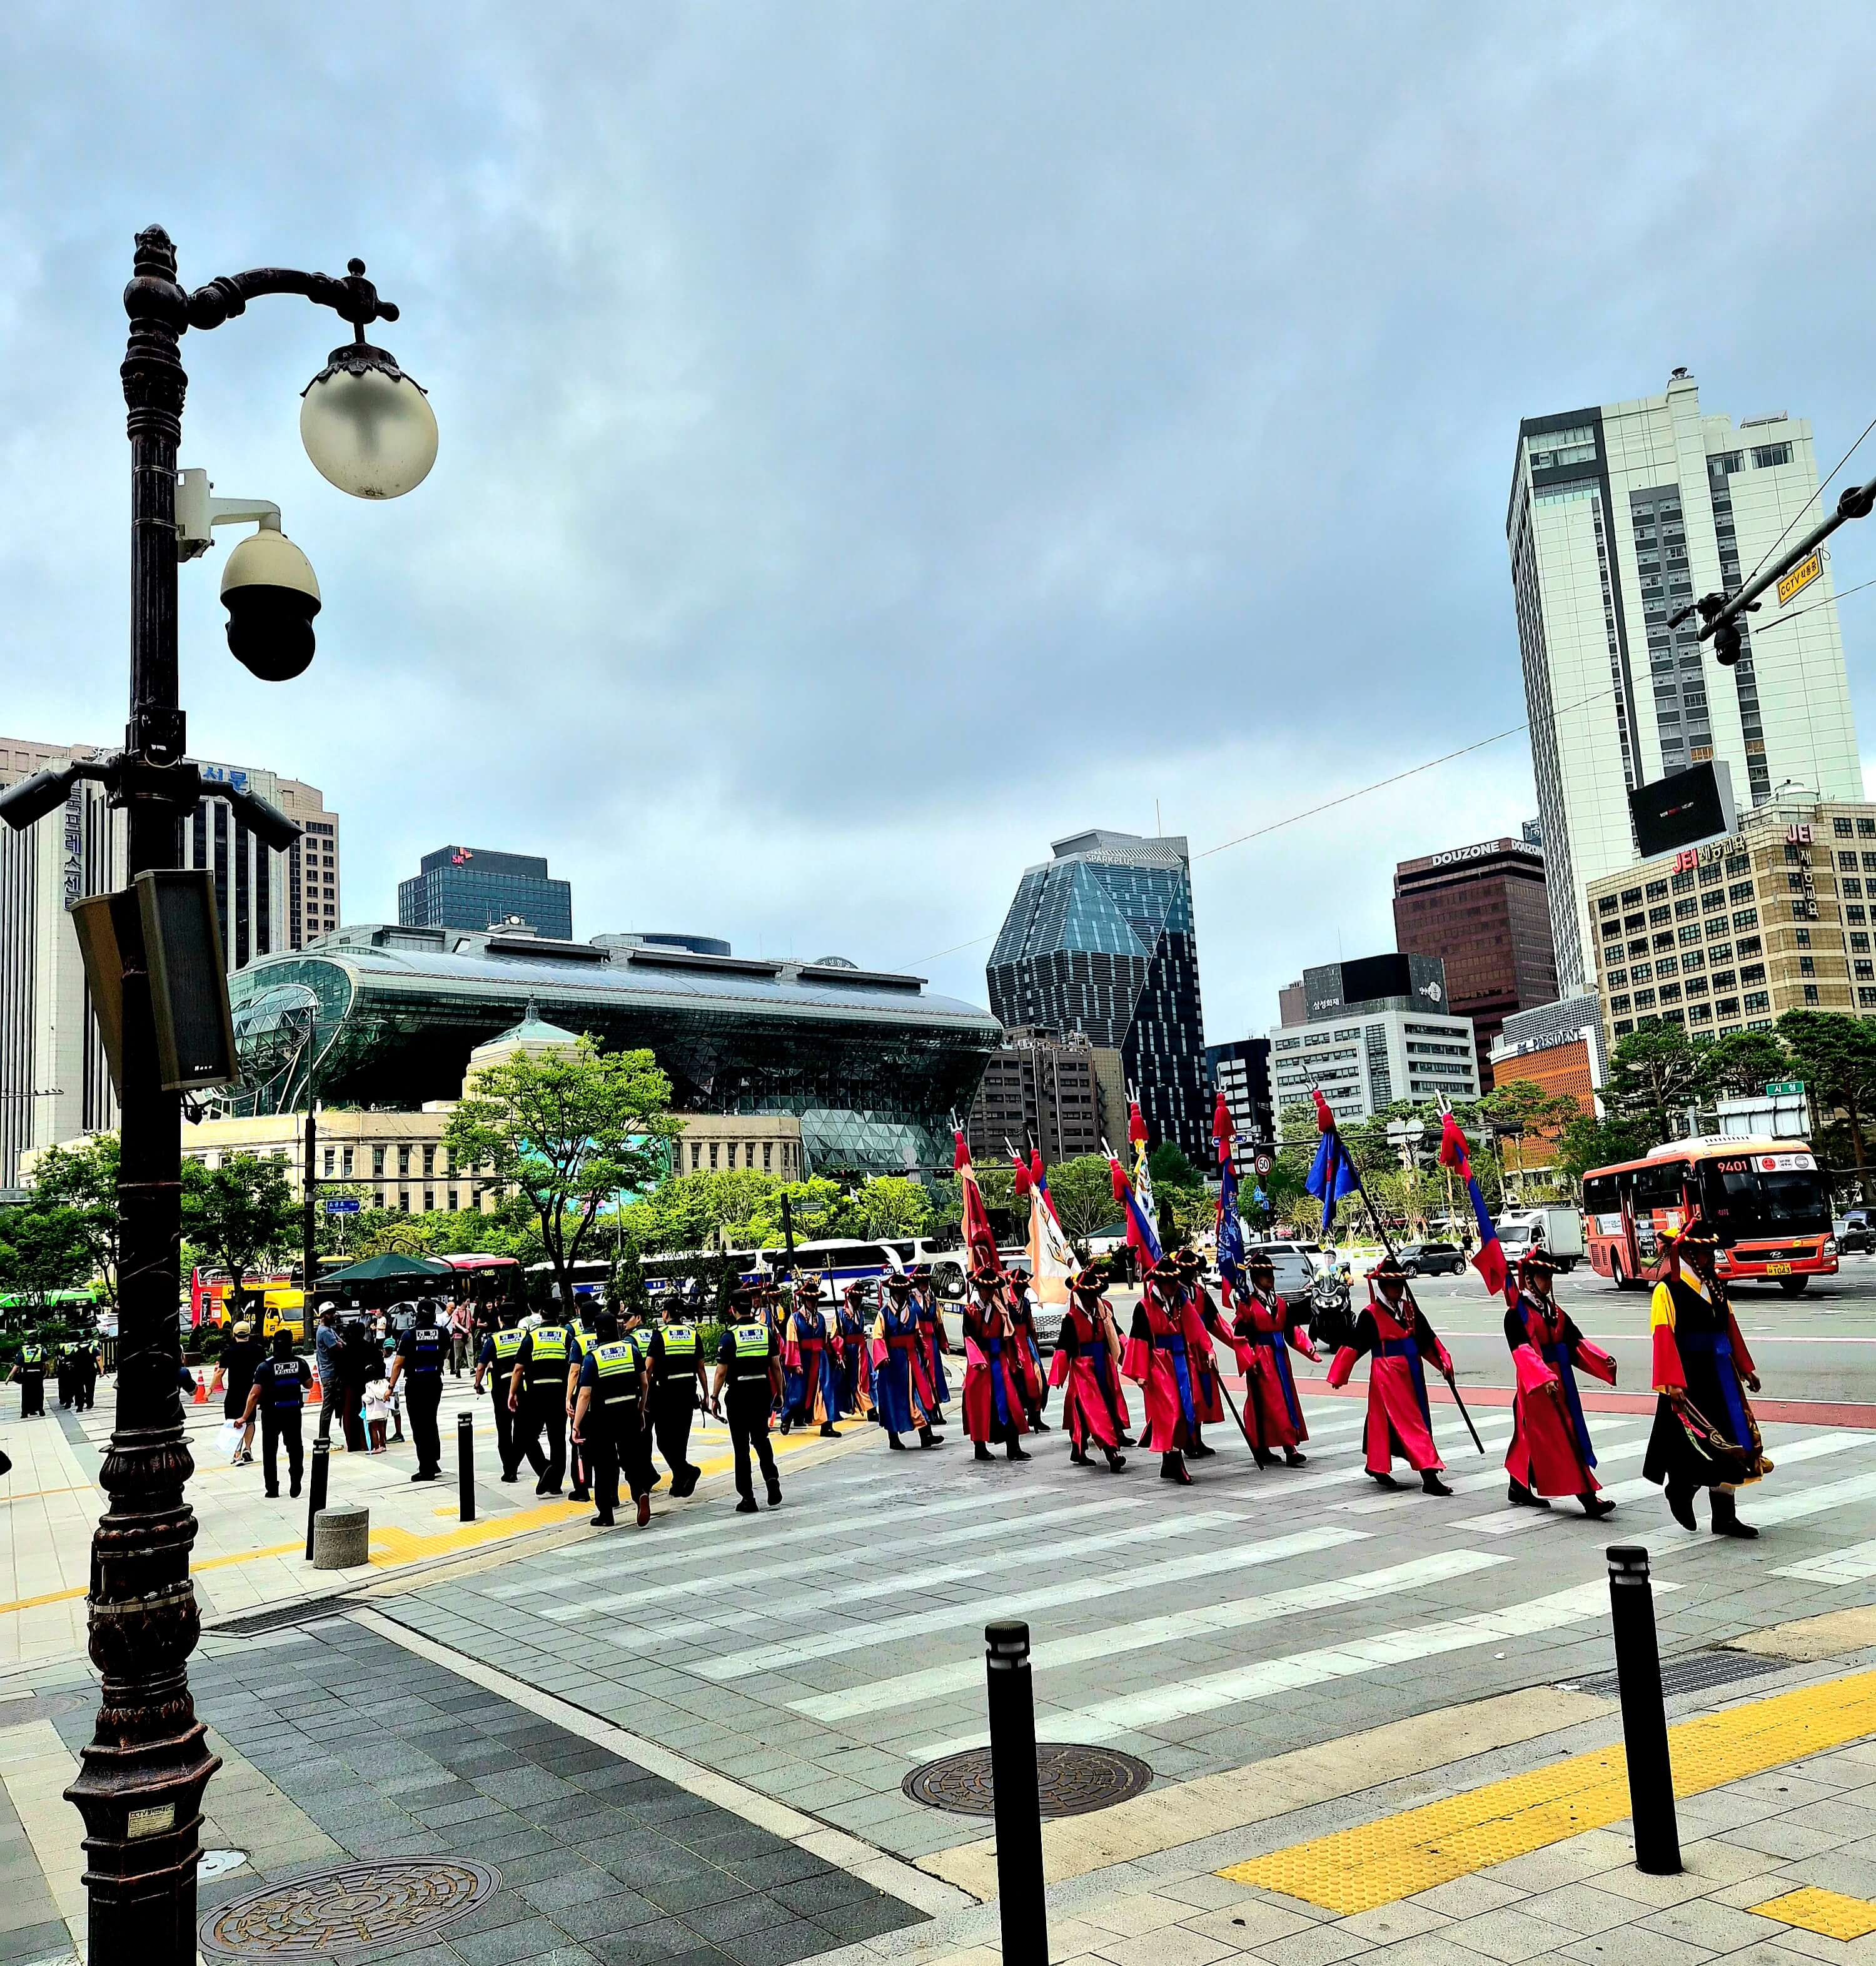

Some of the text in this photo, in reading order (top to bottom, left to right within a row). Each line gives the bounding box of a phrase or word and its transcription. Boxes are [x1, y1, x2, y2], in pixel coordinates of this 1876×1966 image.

[1781, 573, 1800, 596] CCTV
[1786, 824, 1815, 843] JEI
[452, 855, 464, 864] SK
[1431, 841, 1500, 866] DOUZONE
[1672, 848, 1699, 874] JEI
[1313, 998, 1339, 1010] 삼성화재
[1533, 1029, 1581, 1050] PRESIDENT
[1259, 1159, 1268, 1169] 50
[1718, 1161, 1747, 1172] 9401
